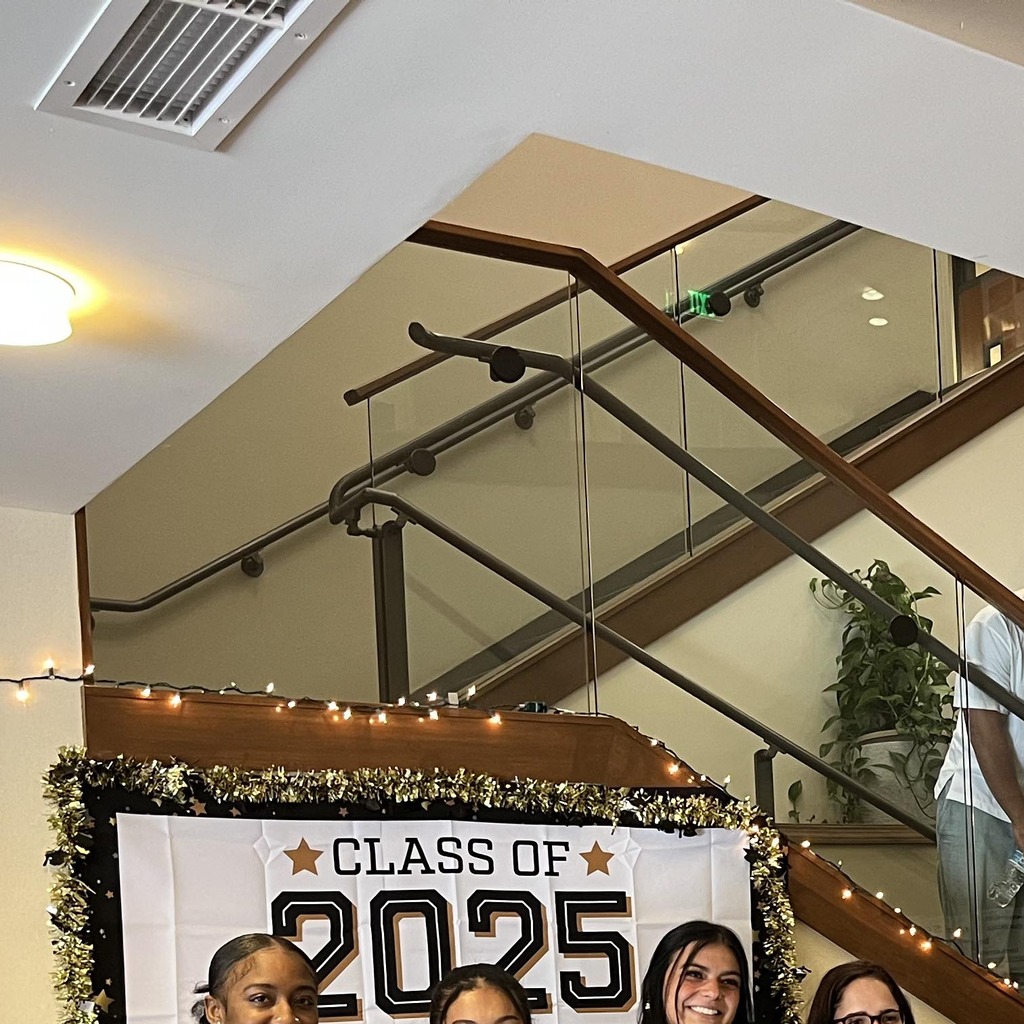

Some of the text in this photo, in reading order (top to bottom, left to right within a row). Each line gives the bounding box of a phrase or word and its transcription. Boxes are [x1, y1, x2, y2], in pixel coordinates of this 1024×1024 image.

[333, 837, 570, 877] CLASS OF
[271, 889, 635, 1021] 2025
